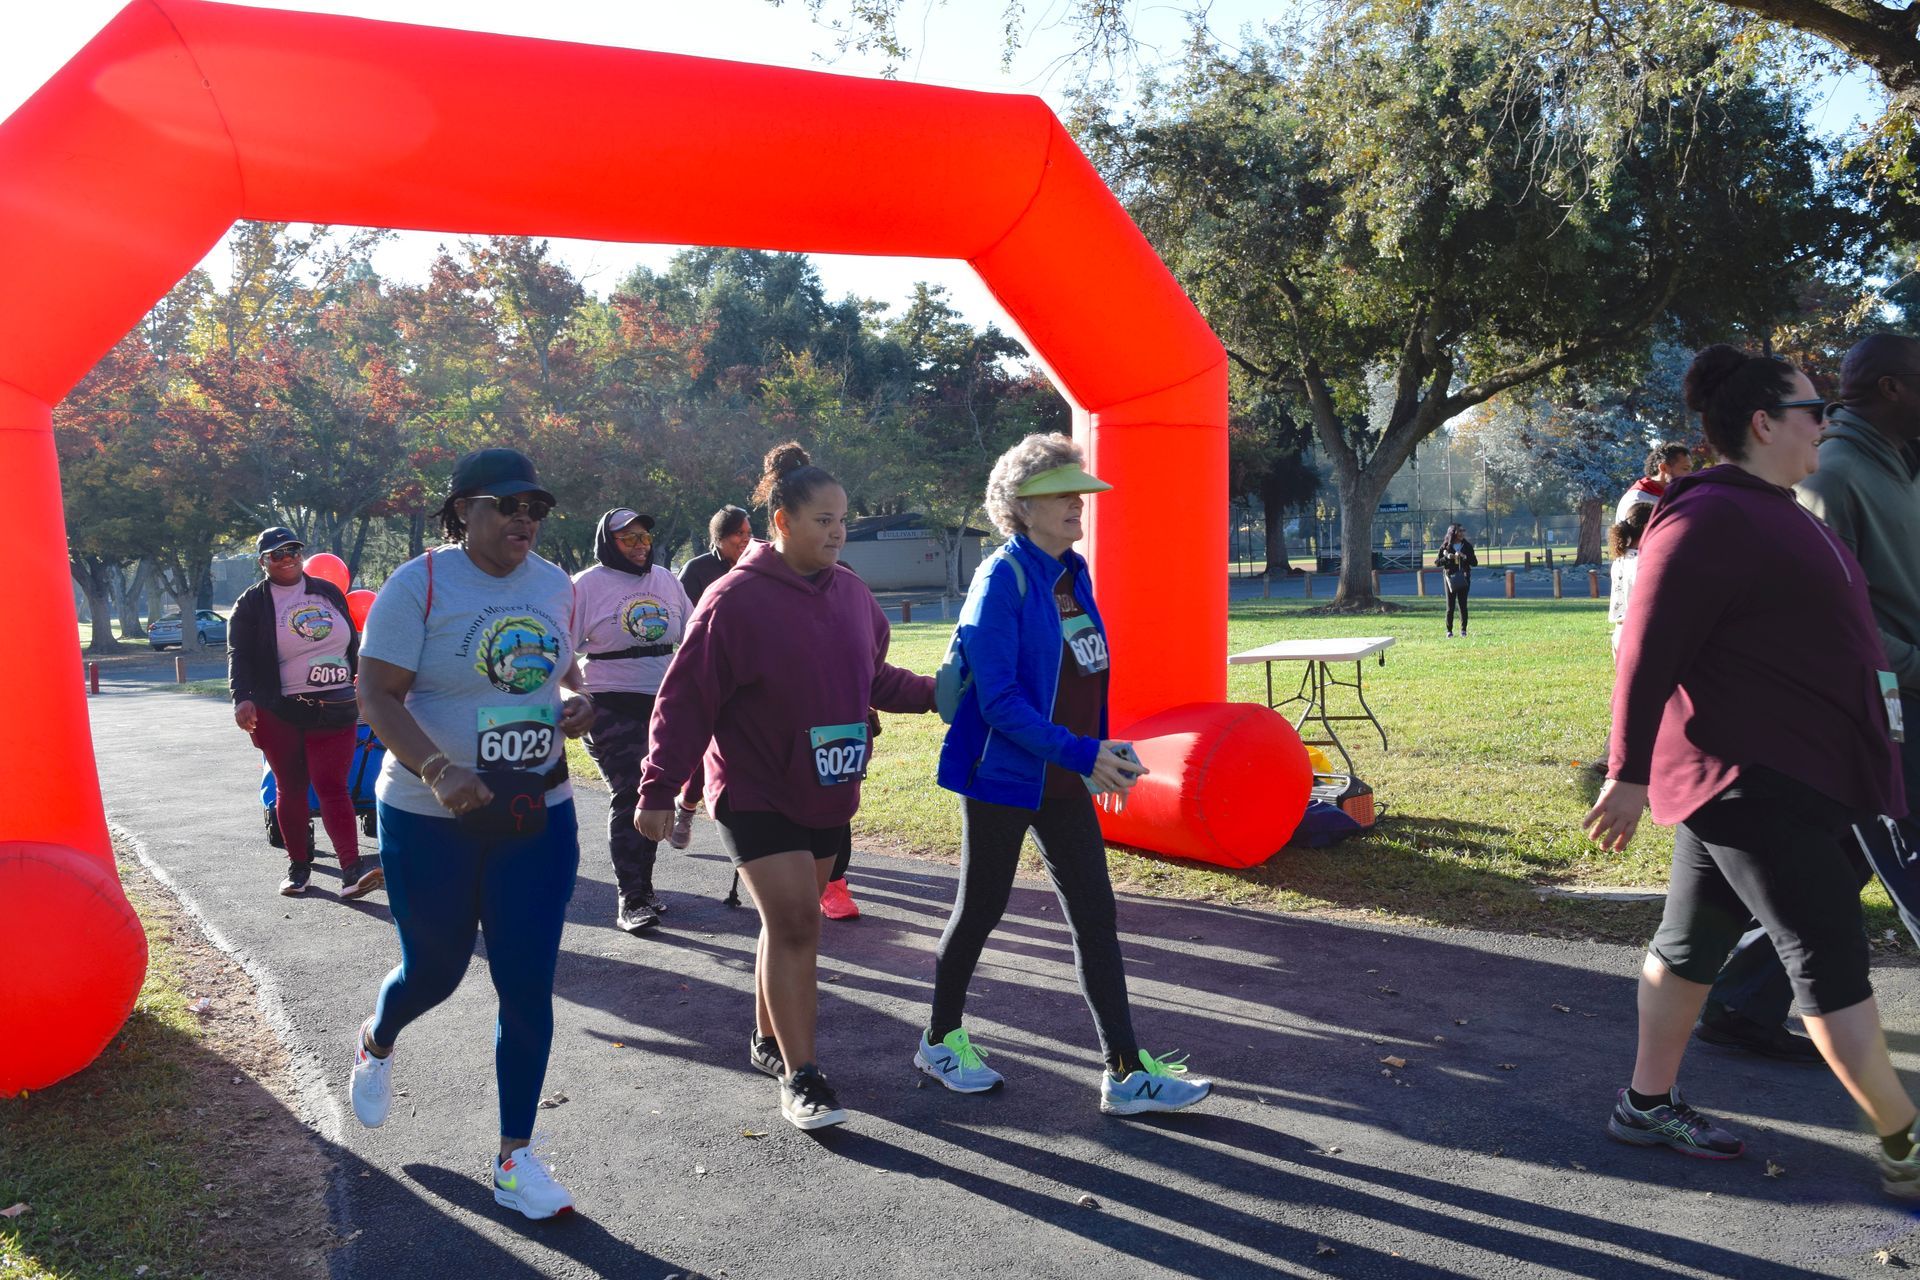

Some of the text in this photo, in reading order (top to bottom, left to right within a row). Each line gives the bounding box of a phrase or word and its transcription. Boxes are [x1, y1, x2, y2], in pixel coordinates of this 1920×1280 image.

[455, 615, 487, 658] Lamont
[482, 605, 523, 617] Meyers
[310, 666, 347, 683] 6018
[481, 728, 552, 762] 6023
[815, 744, 866, 777] 6027
[1135, 1080, 1164, 1100] N
